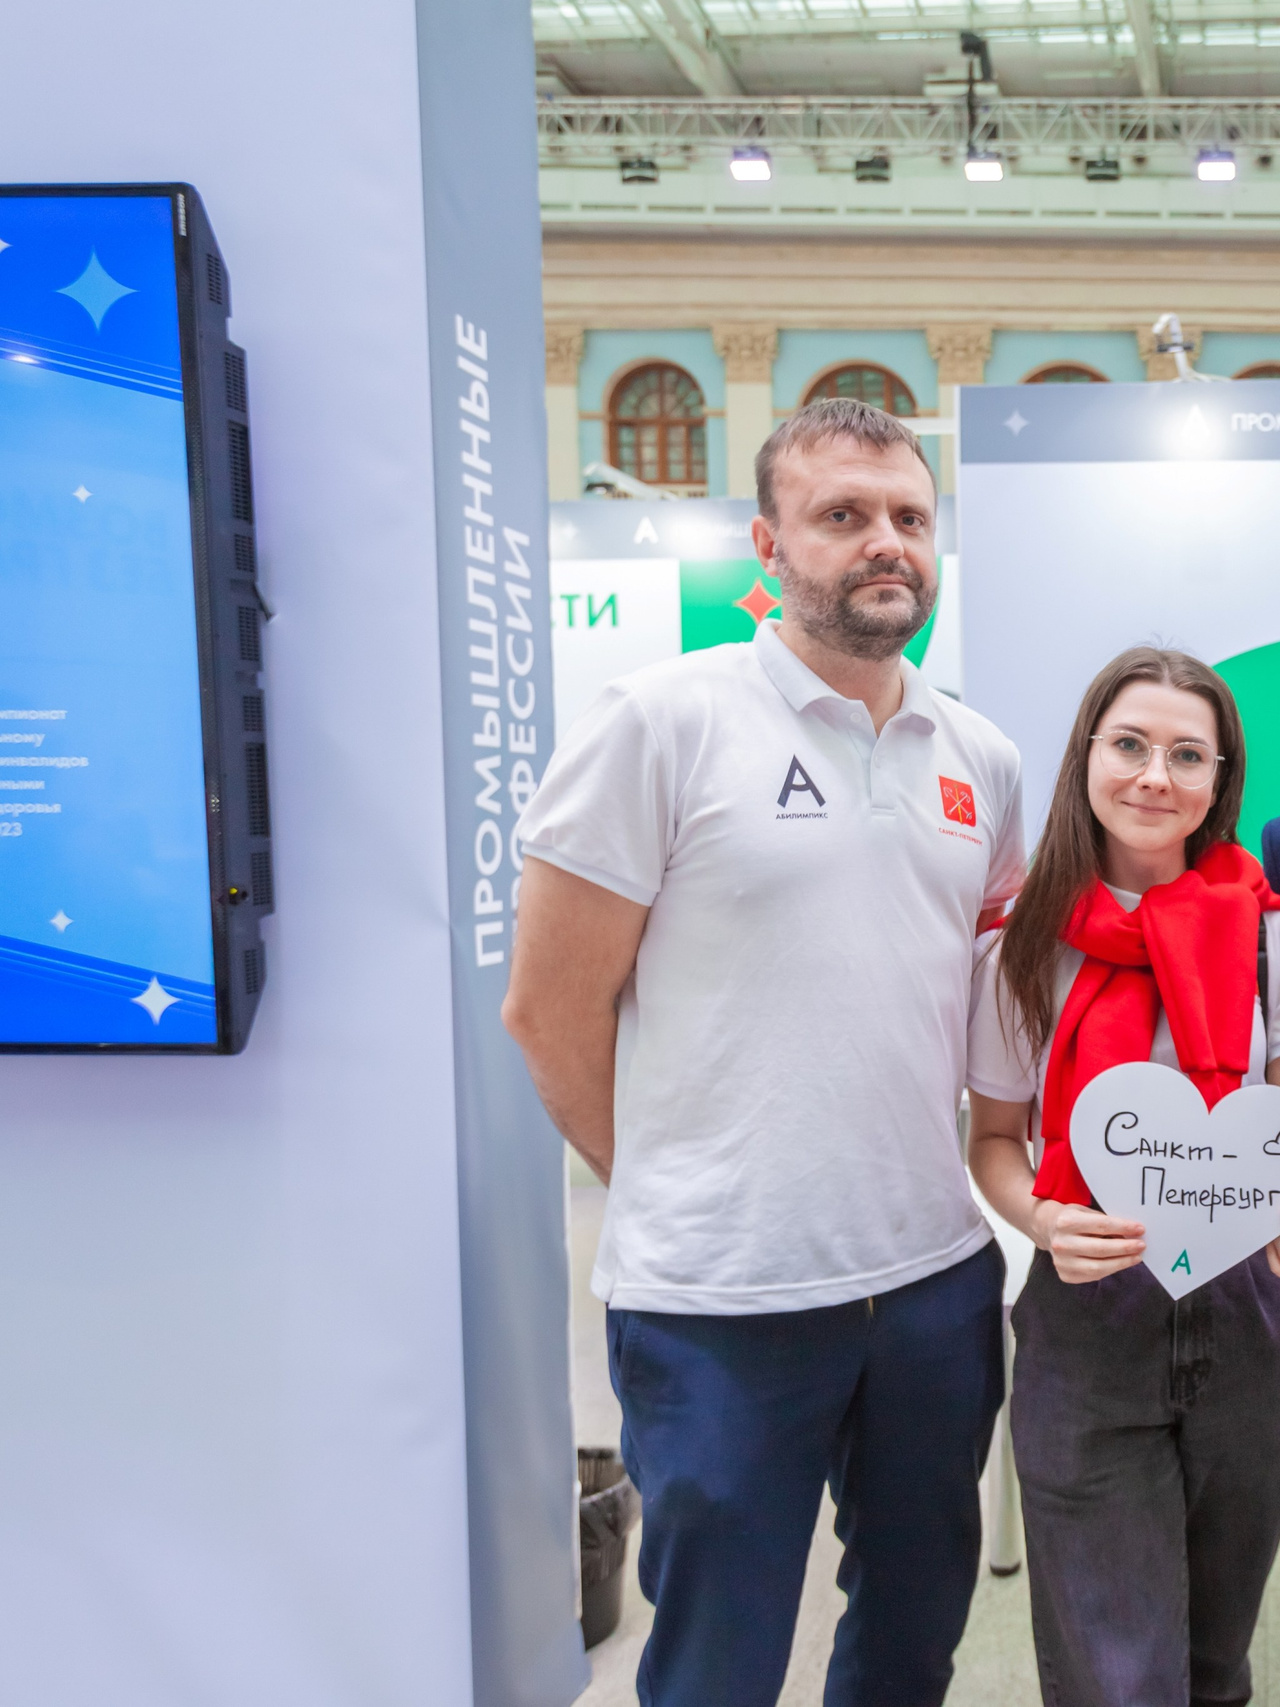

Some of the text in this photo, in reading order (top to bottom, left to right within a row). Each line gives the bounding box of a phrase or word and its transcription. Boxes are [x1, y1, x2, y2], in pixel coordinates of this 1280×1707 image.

[552, 592, 619, 628] ТИ
[455, 313, 505, 968] ПРОМЫШЛЕННЫЕ
[775, 812, 829, 820] АБИЛИМПИКС
